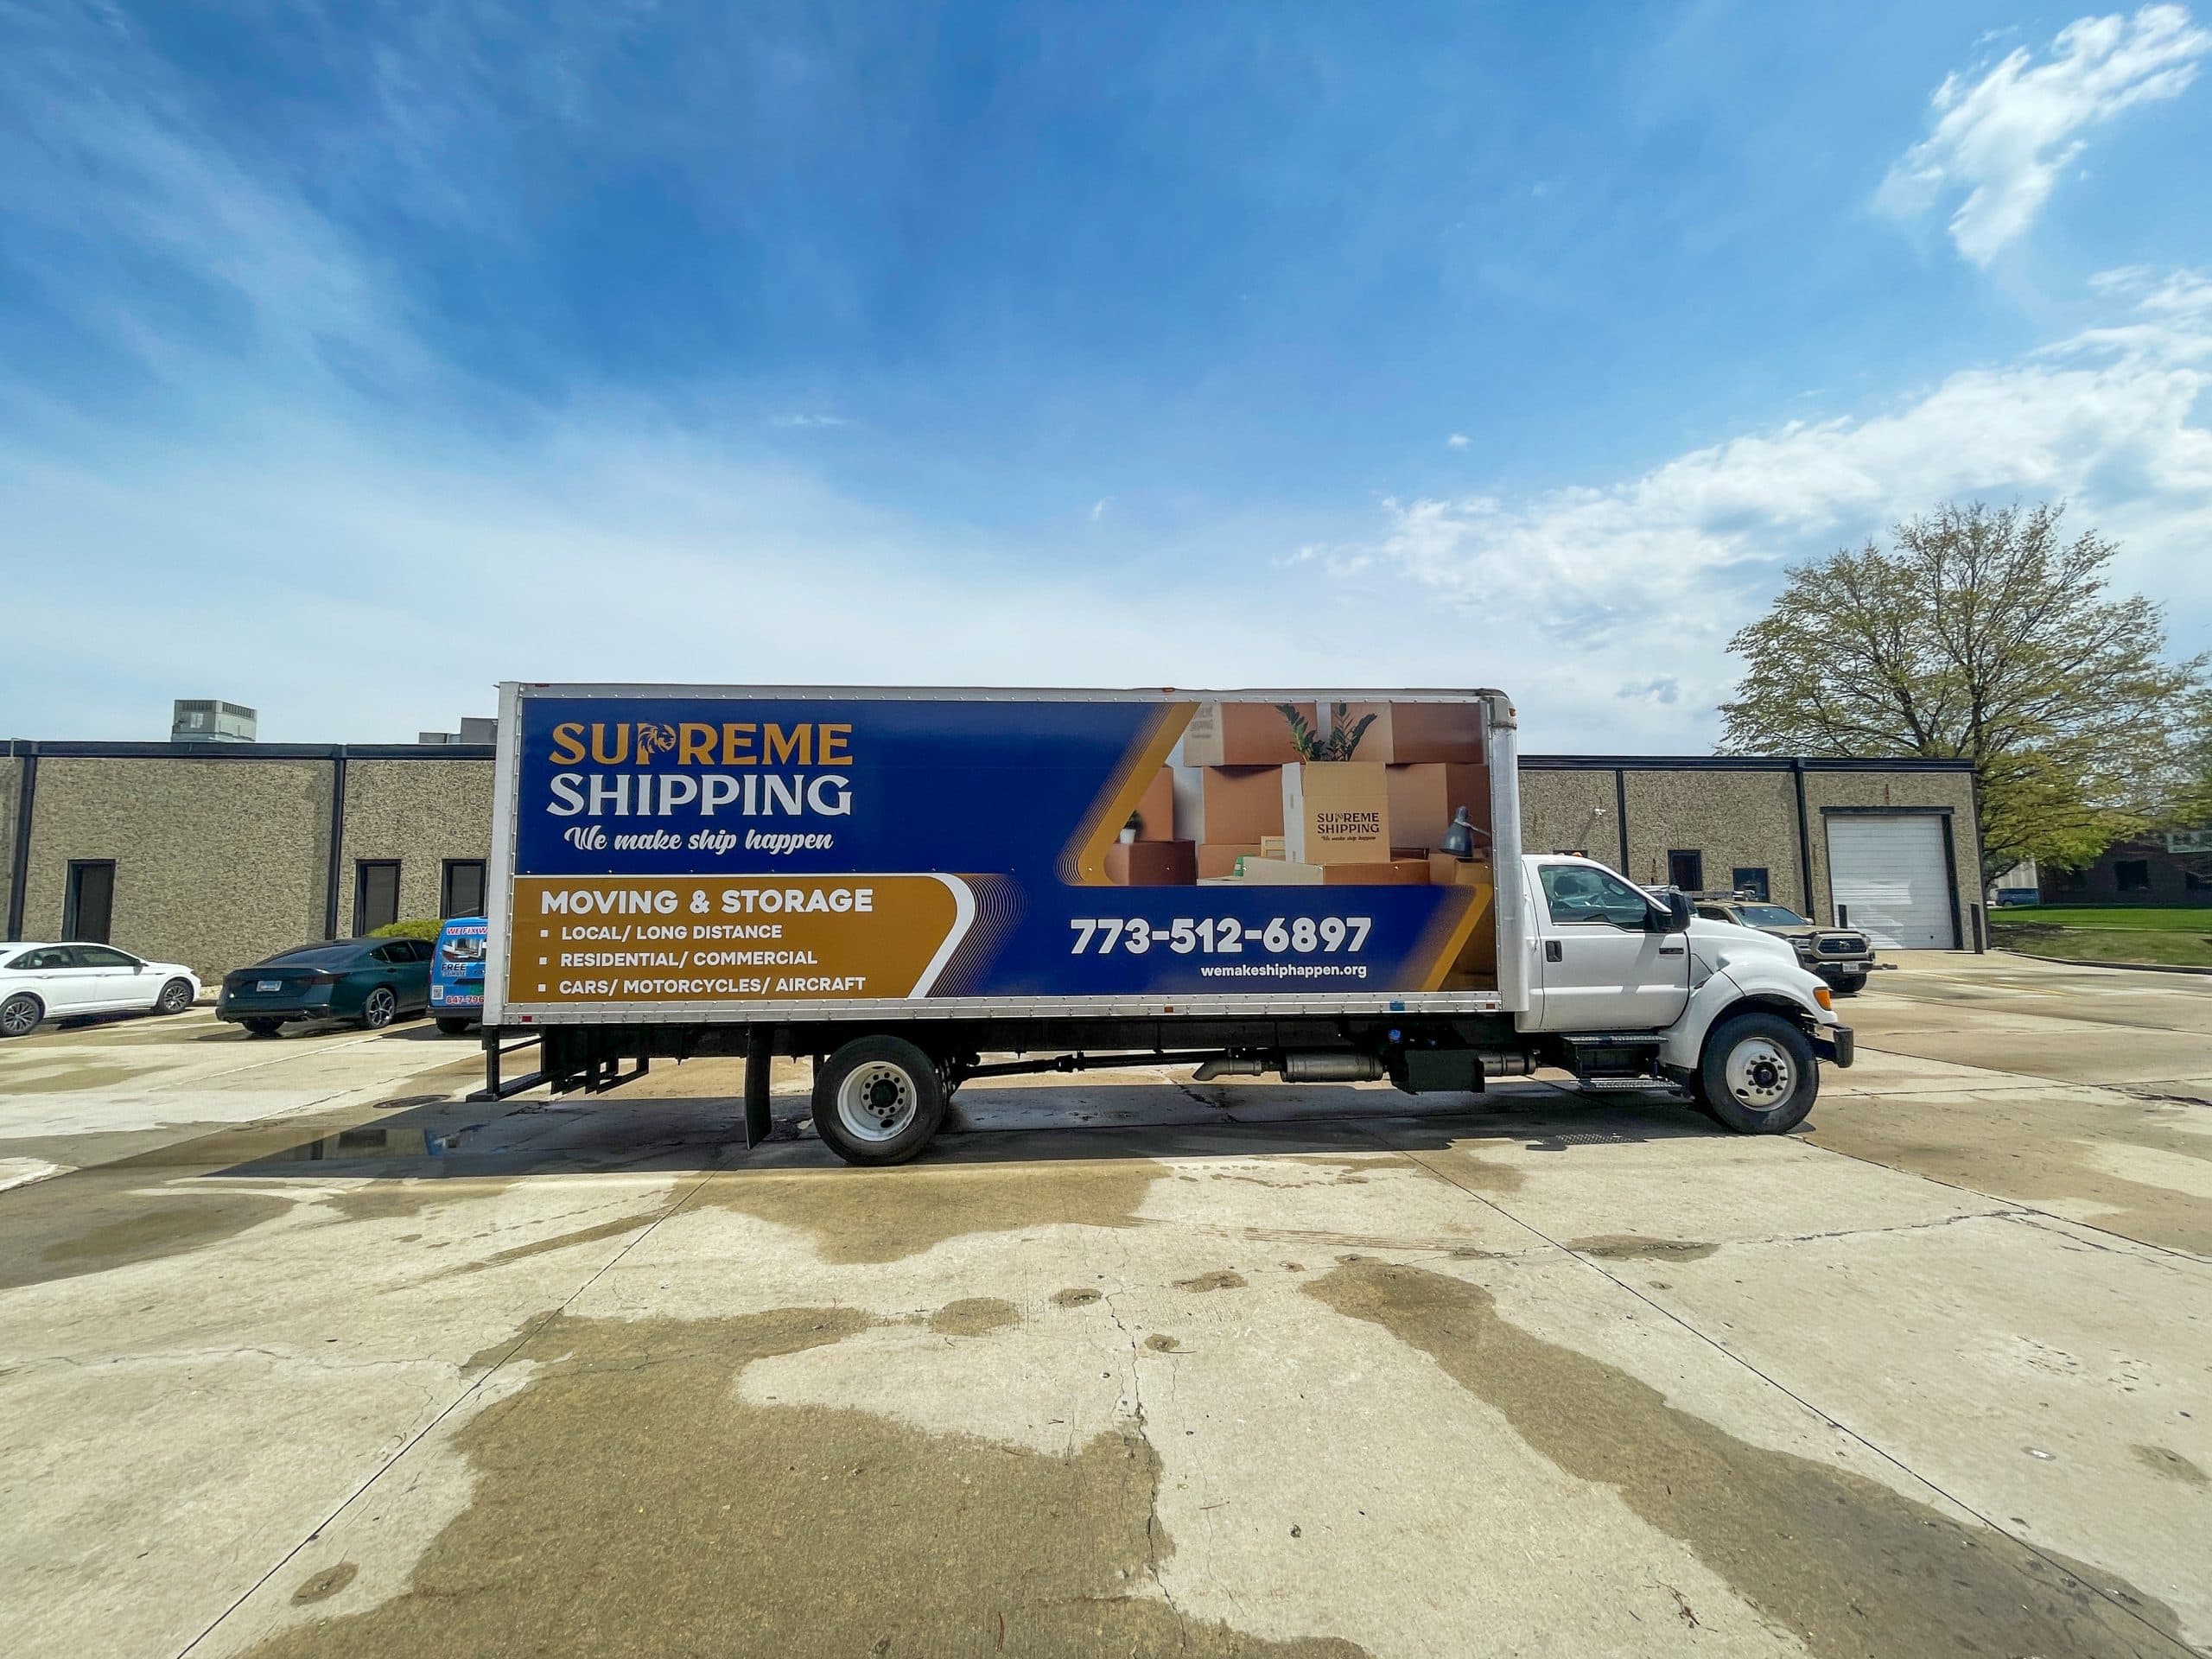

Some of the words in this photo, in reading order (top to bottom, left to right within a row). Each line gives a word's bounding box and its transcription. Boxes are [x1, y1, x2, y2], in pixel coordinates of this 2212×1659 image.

[549, 722, 853, 766] SUPREME
[546, 772, 852, 816] SHIPPING
[1317, 812, 1380, 823] SUPREME
[1317, 823, 1380, 834] SHIPPING
[563, 825, 607, 850] We
[614, 829, 682, 850] make
[688, 829, 736, 855] ship
[745, 829, 834, 855] happen
[541, 890, 678, 914] MOVING
[690, 889, 710, 913] &
[721, 888, 874, 913] STORAGE
[562, 925, 632, 942] LOCAL/
[637, 925, 688, 940] LONG
[692, 925, 782, 939] DISTANCE
[1071, 918, 1371, 954] 773-512-6897
[560, 951, 689, 968] RESIDENTIAL/
[693, 950, 818, 966] COMMERCIAL
[1201, 964, 1367, 978] wemakeshiphappen.org
[558, 979, 618, 995] CARS/
[623, 977, 771, 995] MOTORCYCLES/
[775, 976, 867, 992] AIRCRAFT
